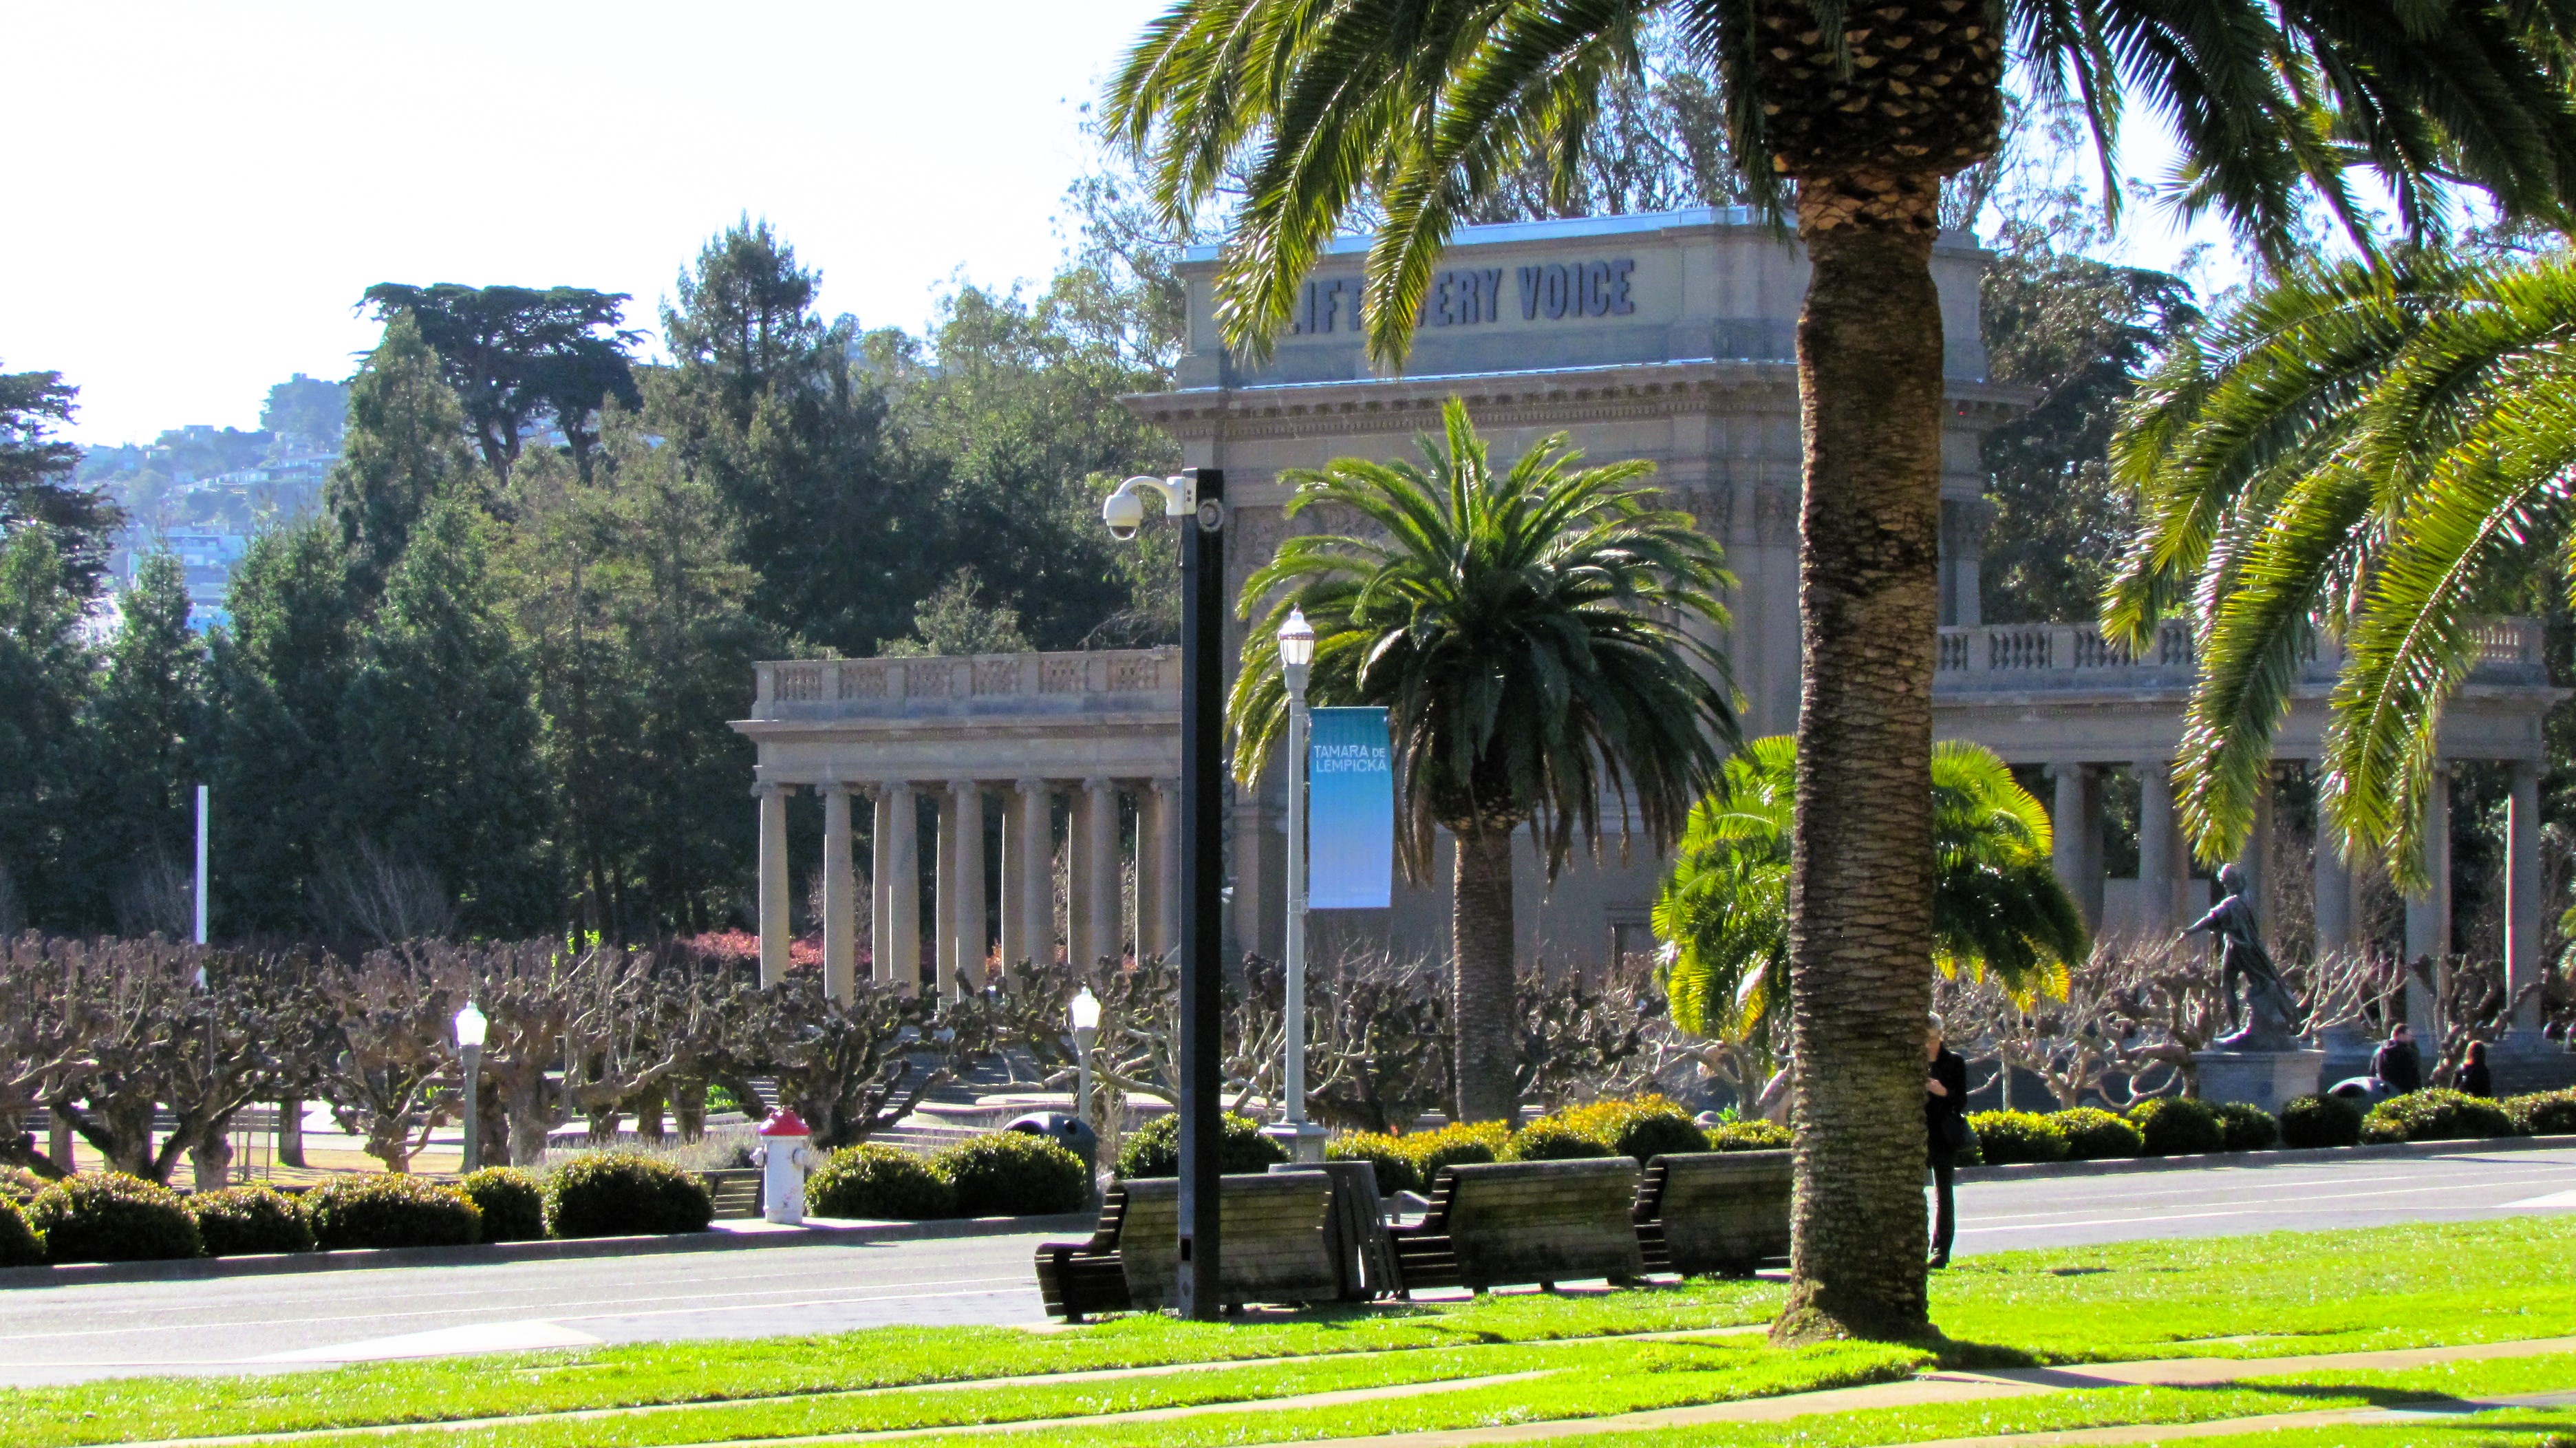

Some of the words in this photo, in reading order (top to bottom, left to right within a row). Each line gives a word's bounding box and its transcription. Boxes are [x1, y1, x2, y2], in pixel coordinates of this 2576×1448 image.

[1287, 277, 1365, 334] IFT
[1516, 259, 1635, 320] VOICE
[1314, 745, 1368, 758] TAMARA
[1372, 747, 1386, 758] DE
[1316, 759, 1387, 771] LEMPICKA
